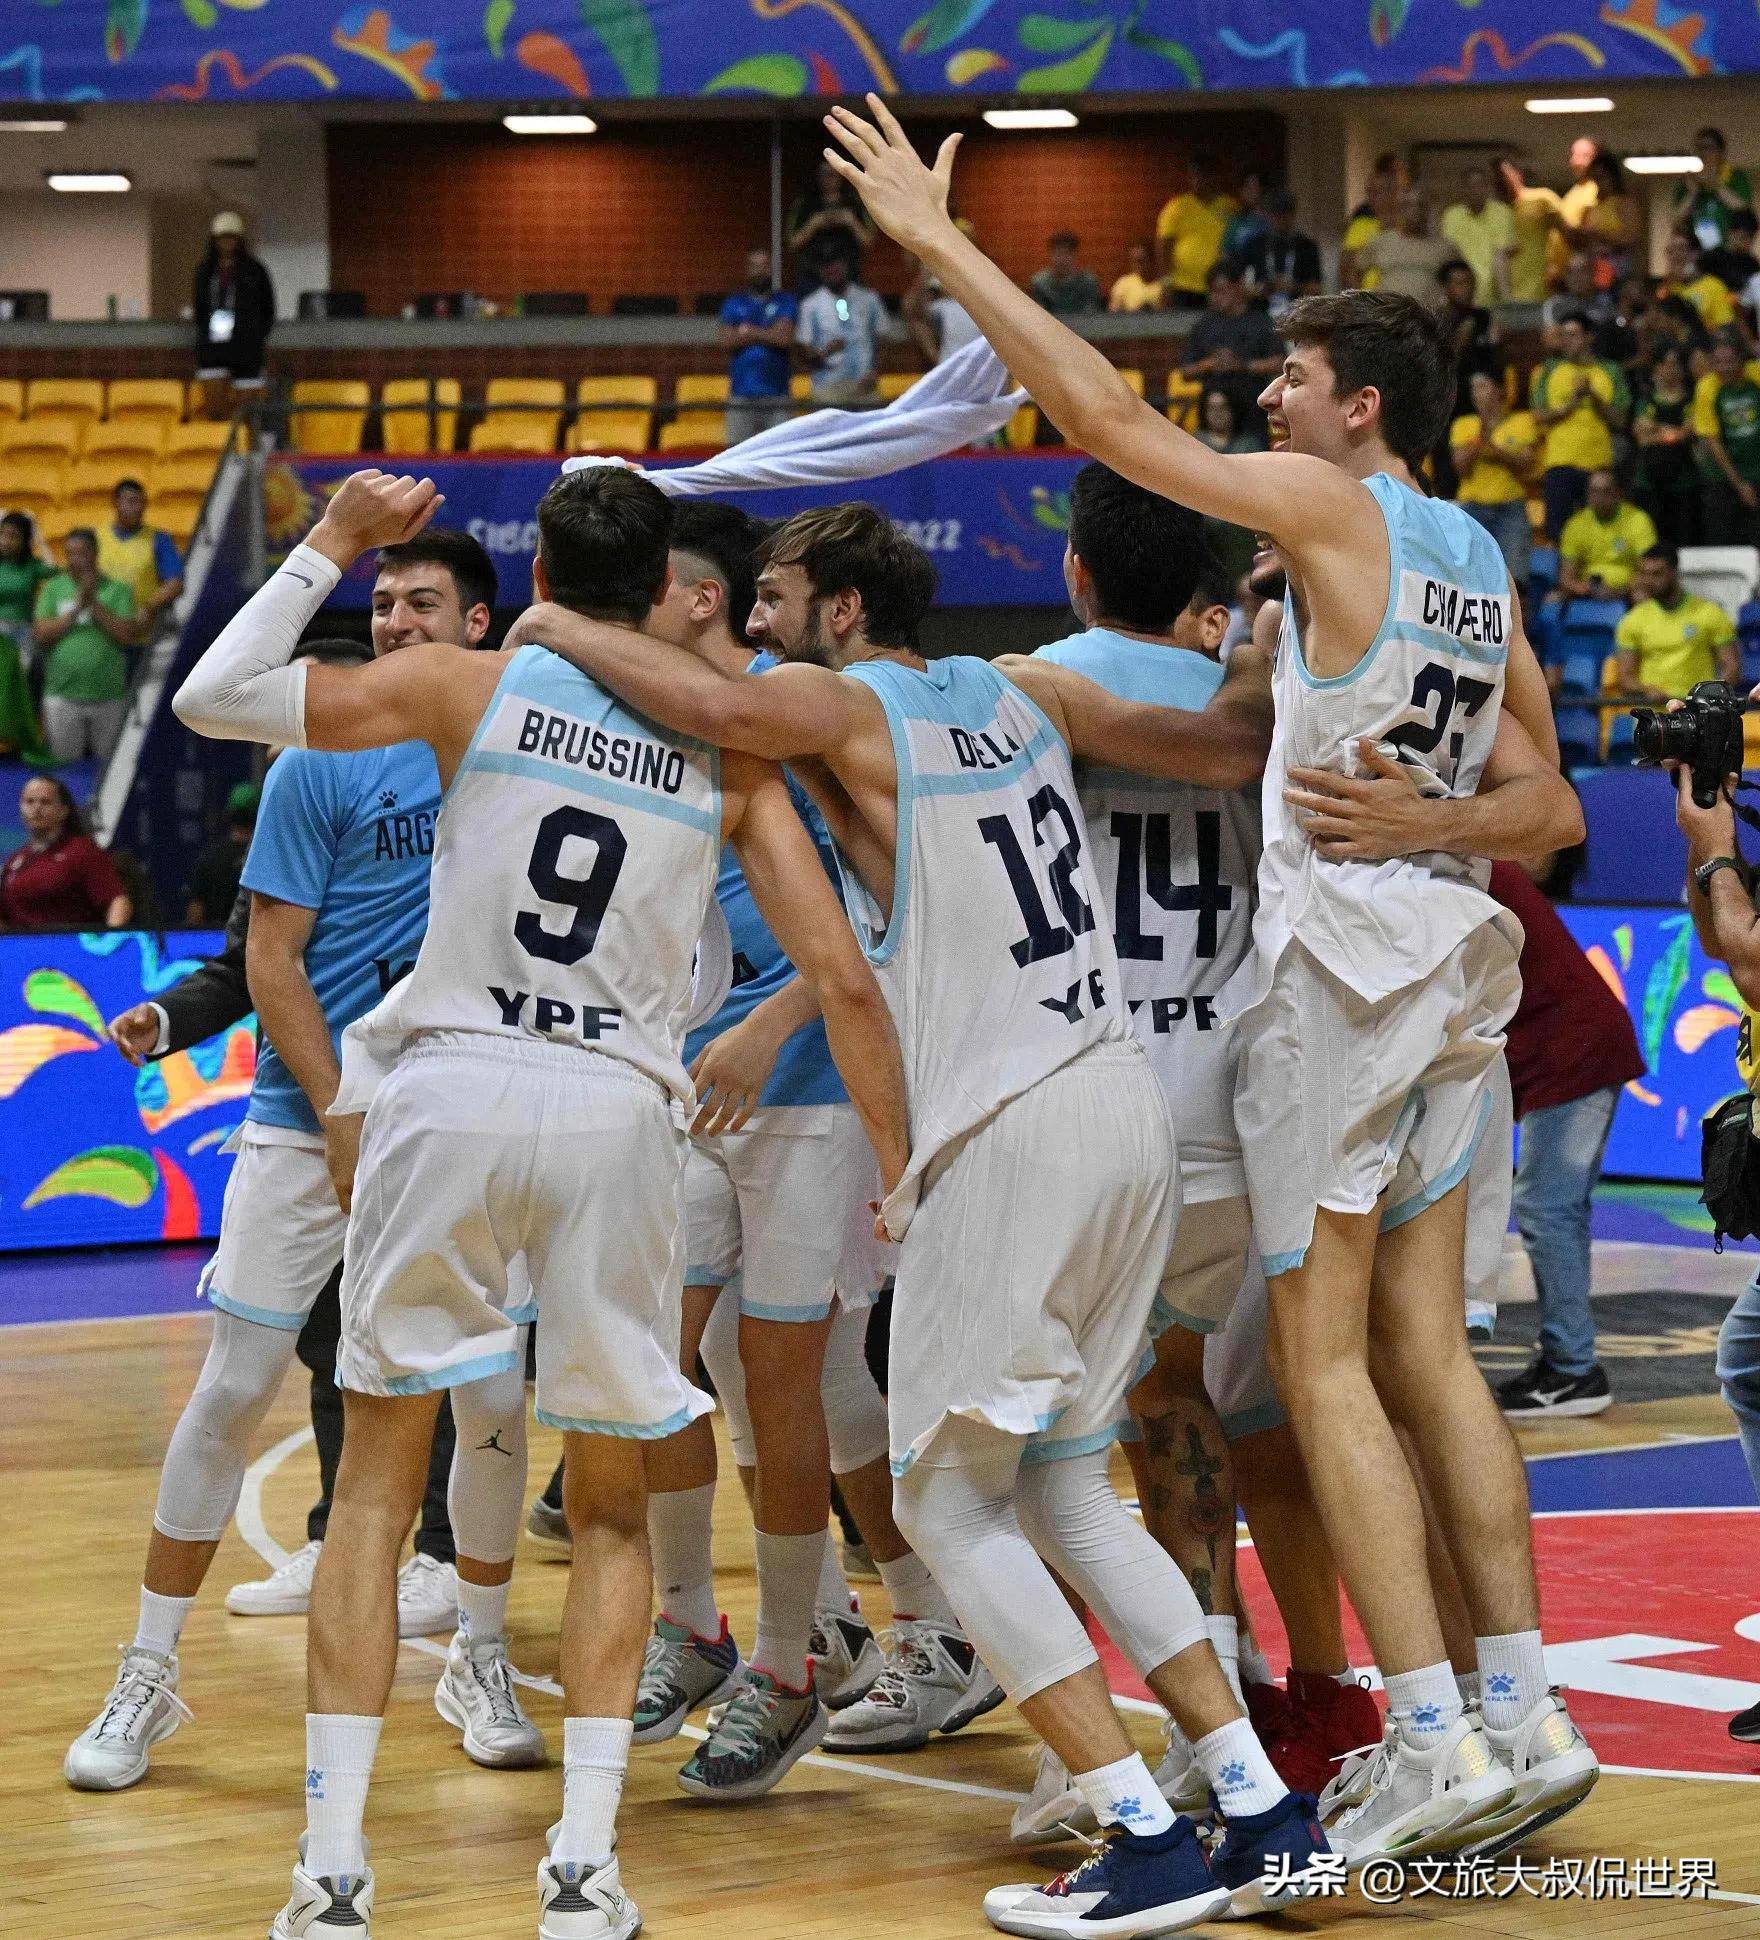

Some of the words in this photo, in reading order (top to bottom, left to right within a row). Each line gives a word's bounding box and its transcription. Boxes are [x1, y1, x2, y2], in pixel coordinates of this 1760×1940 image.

[517, 708, 686, 795] BRUSSINO
[374, 808, 440, 862] ARG
[976, 783, 1096, 969] 12
[513, 804, 629, 967] 9
[1110, 810, 1233, 961] 14
[486, 986, 623, 1040] YPF
[1127, 995, 1219, 1034] PF
